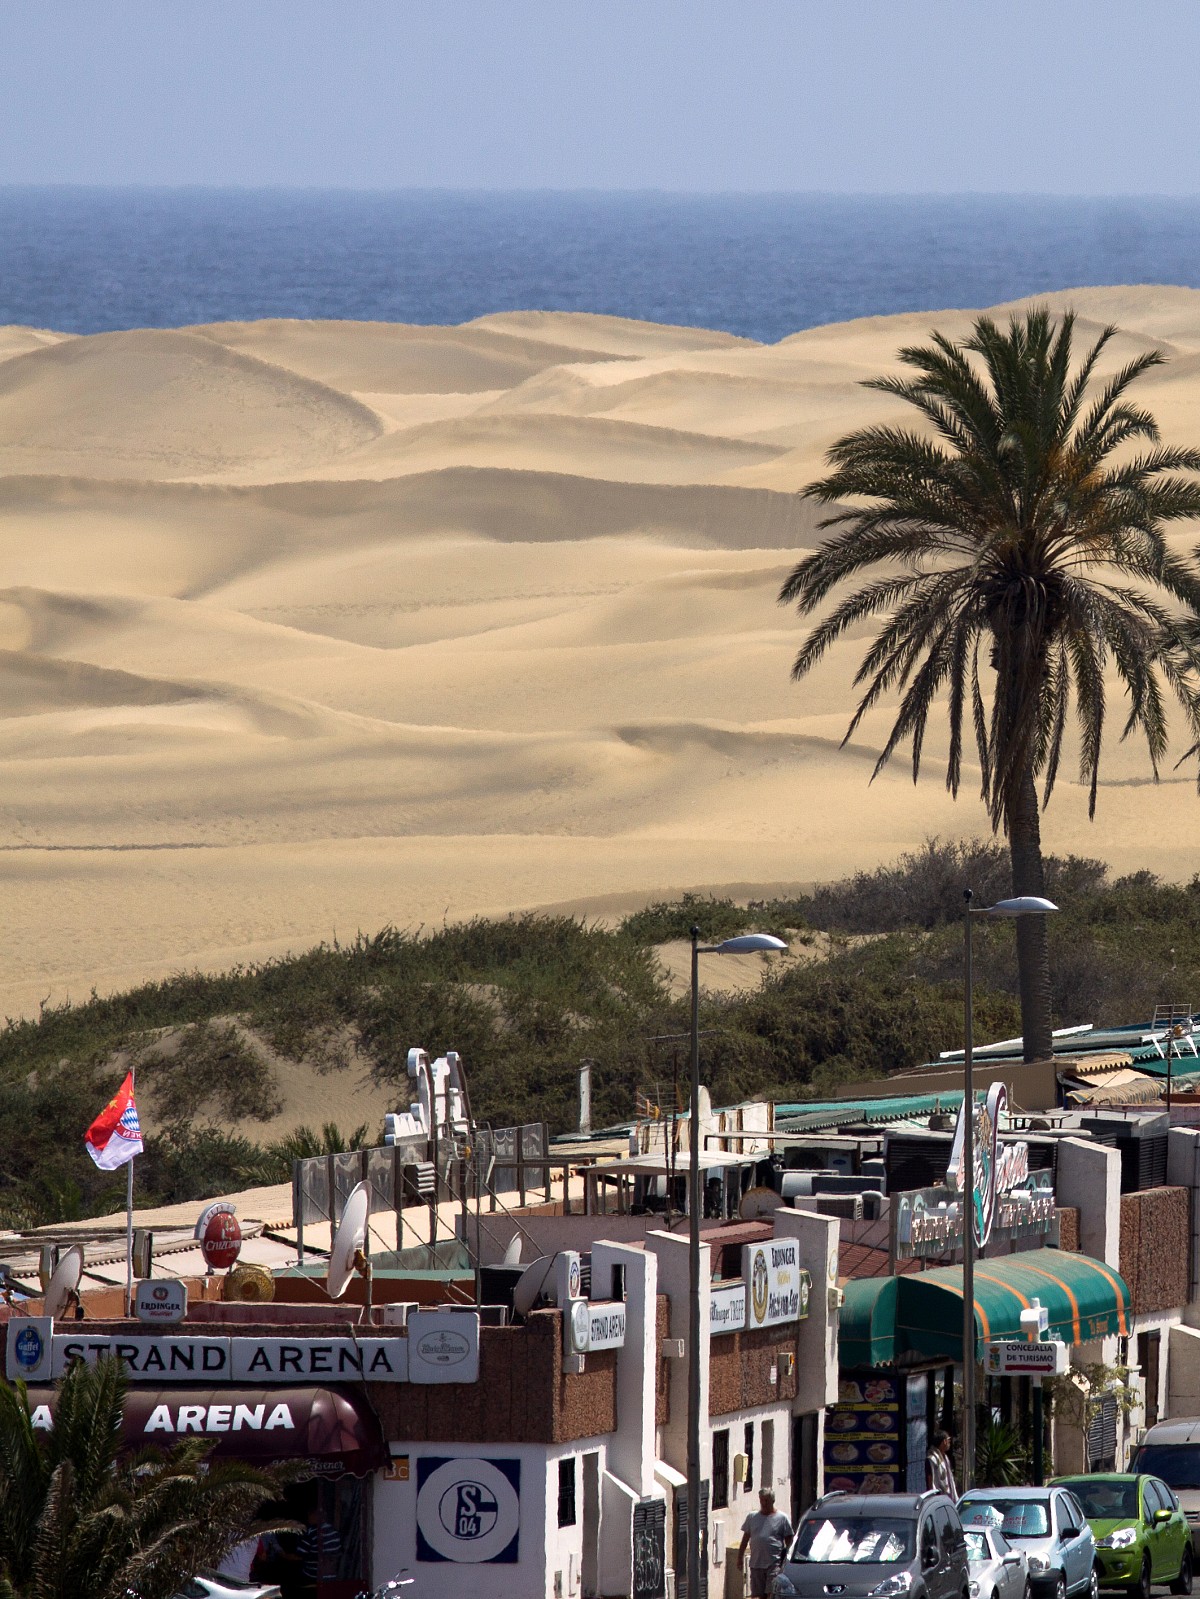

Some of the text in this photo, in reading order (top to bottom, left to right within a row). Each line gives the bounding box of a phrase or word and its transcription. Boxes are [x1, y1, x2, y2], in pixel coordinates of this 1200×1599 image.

[140, 1301, 181, 1311] ERDINGER
[591, 1313, 625, 1342] STRAND ARENA
[63, 1343, 227, 1371] STRAND
[247, 1345, 394, 1373] ARENA
[1006, 1344, 1053, 1353] CONCEJALIA
[1006, 1354, 1054, 1363] DE TURISMO
[143, 1403, 295, 1433] ARENA
